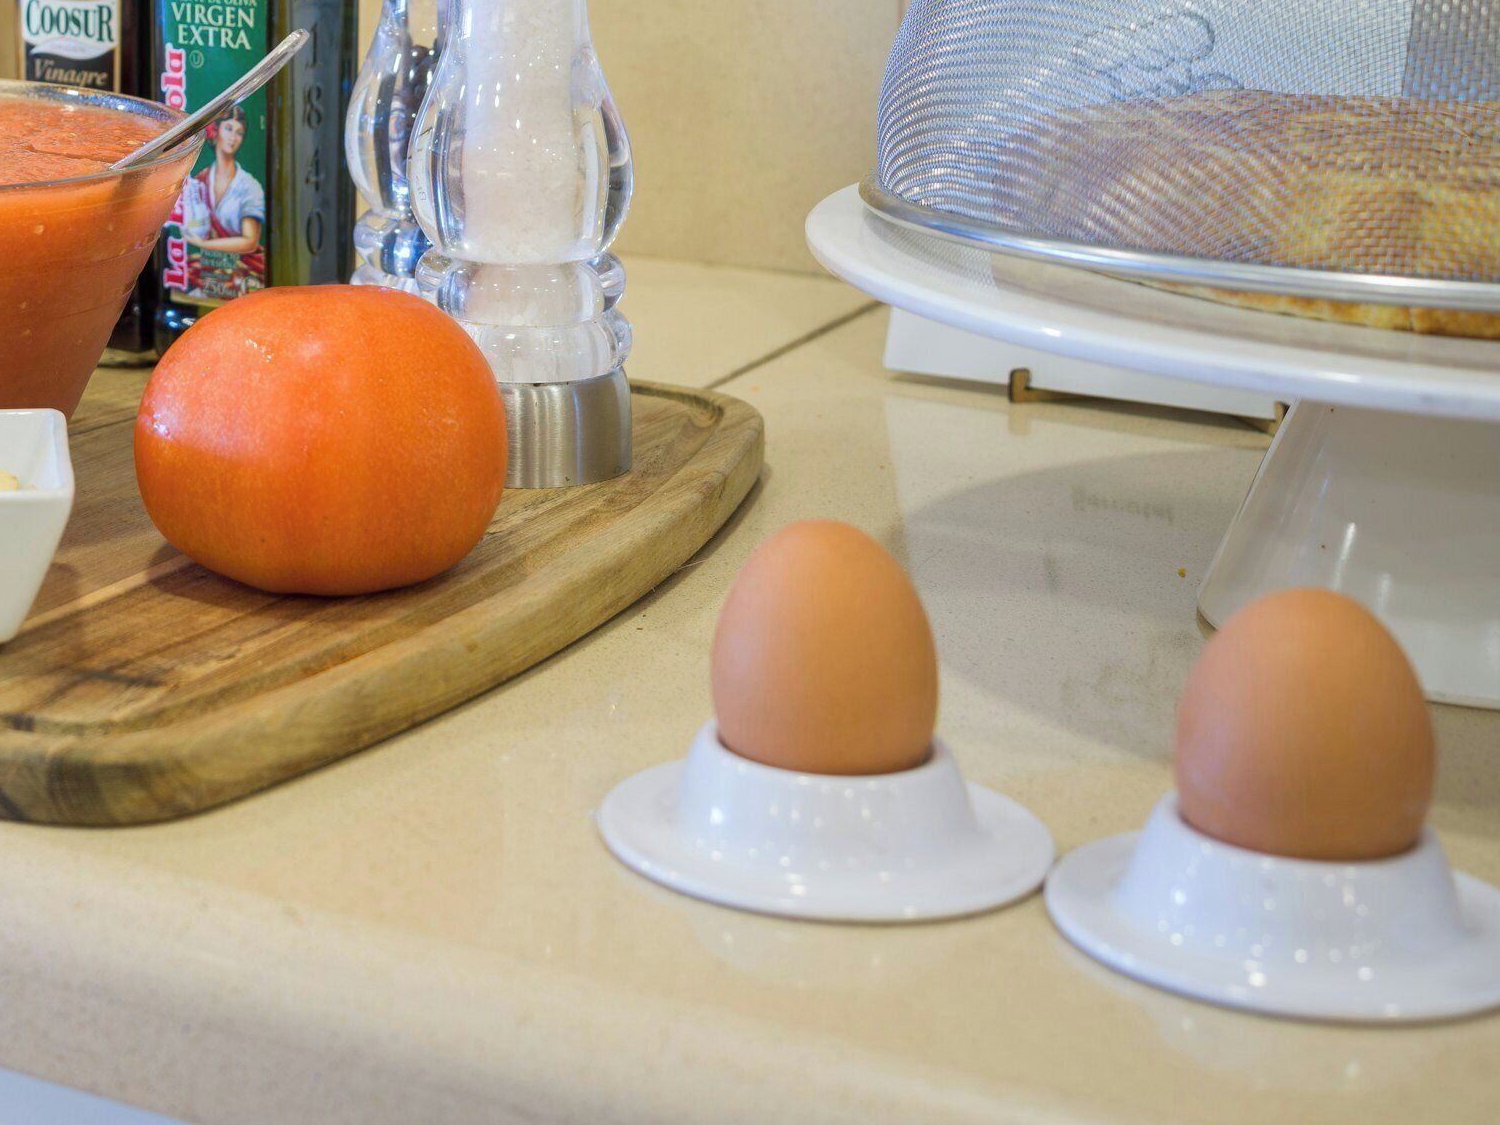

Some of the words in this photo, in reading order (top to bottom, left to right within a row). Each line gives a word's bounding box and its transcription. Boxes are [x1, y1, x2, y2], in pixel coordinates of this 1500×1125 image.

[171, 2, 255, 28] VIRGEN
[177, 25, 252, 50] EXTRA
[34, 58, 109, 88] Vinagre
